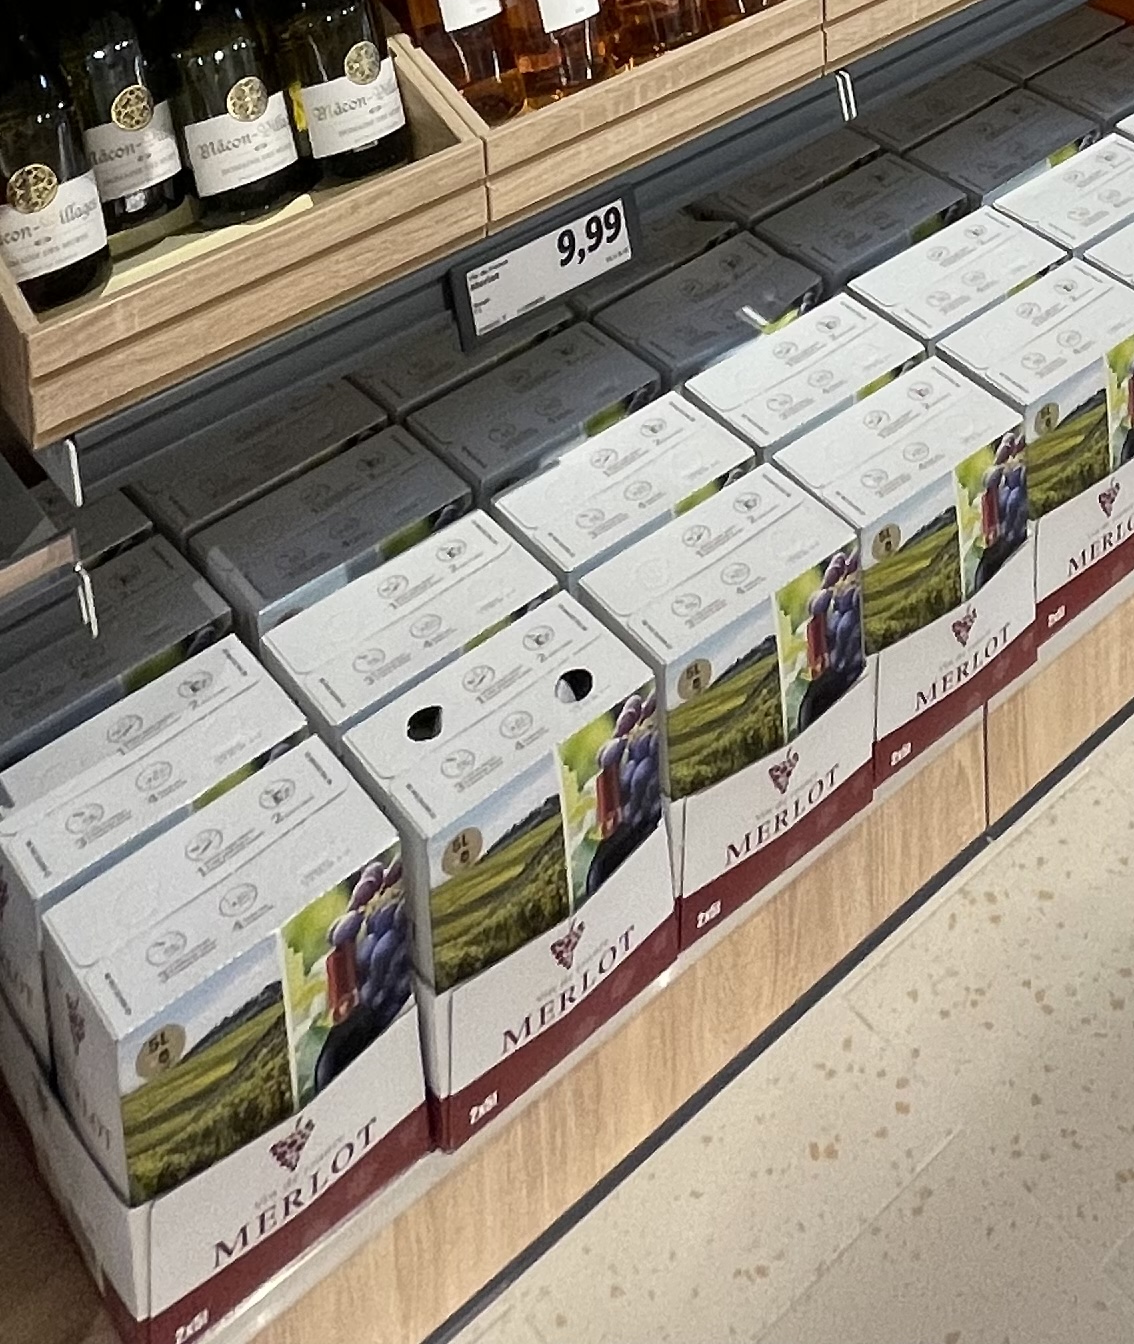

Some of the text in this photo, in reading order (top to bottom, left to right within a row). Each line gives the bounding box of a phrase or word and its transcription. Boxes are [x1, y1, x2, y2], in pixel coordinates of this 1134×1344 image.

[557, 206, 622, 268] 9,99
[914, 621, 1011, 712] MERLOT
[452, 835, 468, 851] 5L
[724, 763, 839, 867] MERLOT
[502, 924, 636, 1054] MERLOT
[147, 1030, 168, 1051] 5L
[213, 1117, 377, 1269] MERLOT
